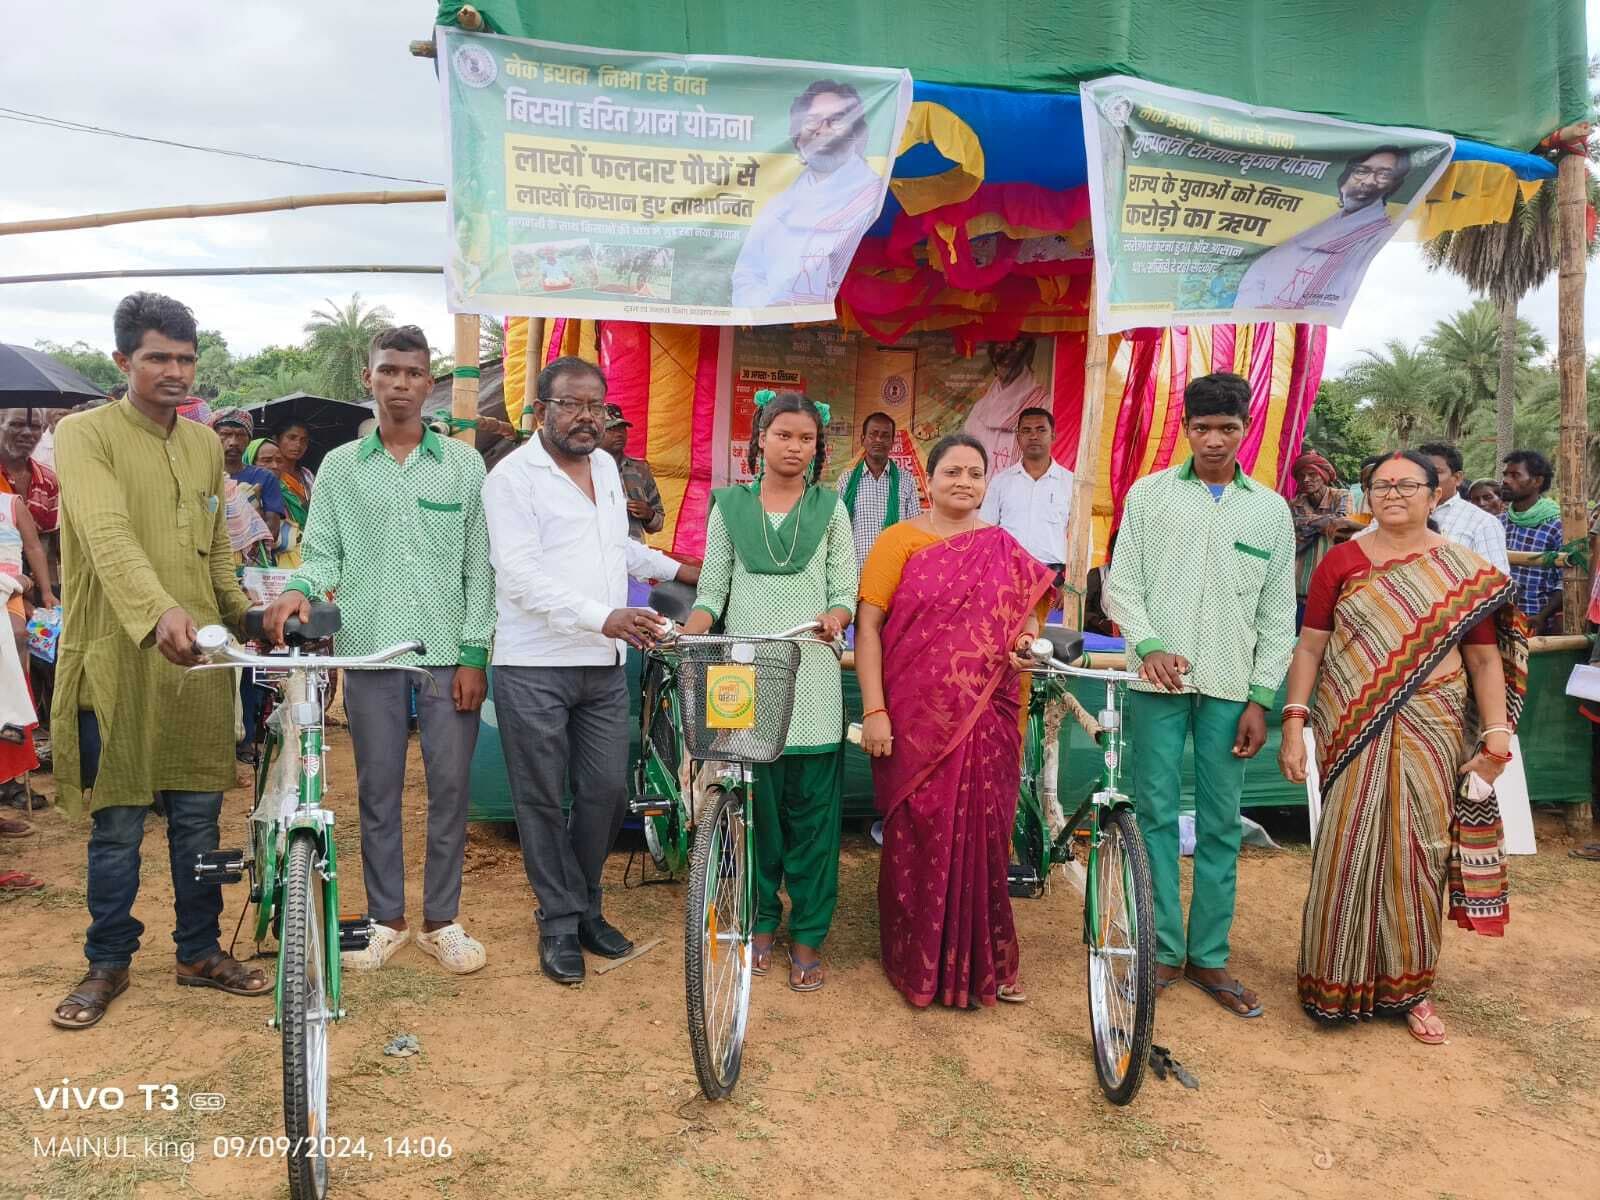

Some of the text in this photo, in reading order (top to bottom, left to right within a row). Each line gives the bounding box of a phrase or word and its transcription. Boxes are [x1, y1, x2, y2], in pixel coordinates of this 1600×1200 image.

[504, 53, 539, 81] नेक
[543, 62, 588, 86] इरादा
[598, 64, 642, 91] निभा
[644, 69, 669, 92] रहे
[672, 76, 709, 96] वादा
[504, 87, 754, 141] बिरसा हरित ग्राम योजना
[512, 143, 761, 188] लाखों फलदार पौधों से
[1188, 141, 1243, 164] रोजगार
[1240, 152, 1282, 175] सृजन
[1281, 155, 1330, 180] योजना
[515, 182, 755, 219] लाखों किसान हुए लाभान्वित
[1129, 171, 1303, 212] राज्य के युवाओं को मिला
[1183, 207, 1216, 229] का
[1216, 211, 1271, 237] ऋण
